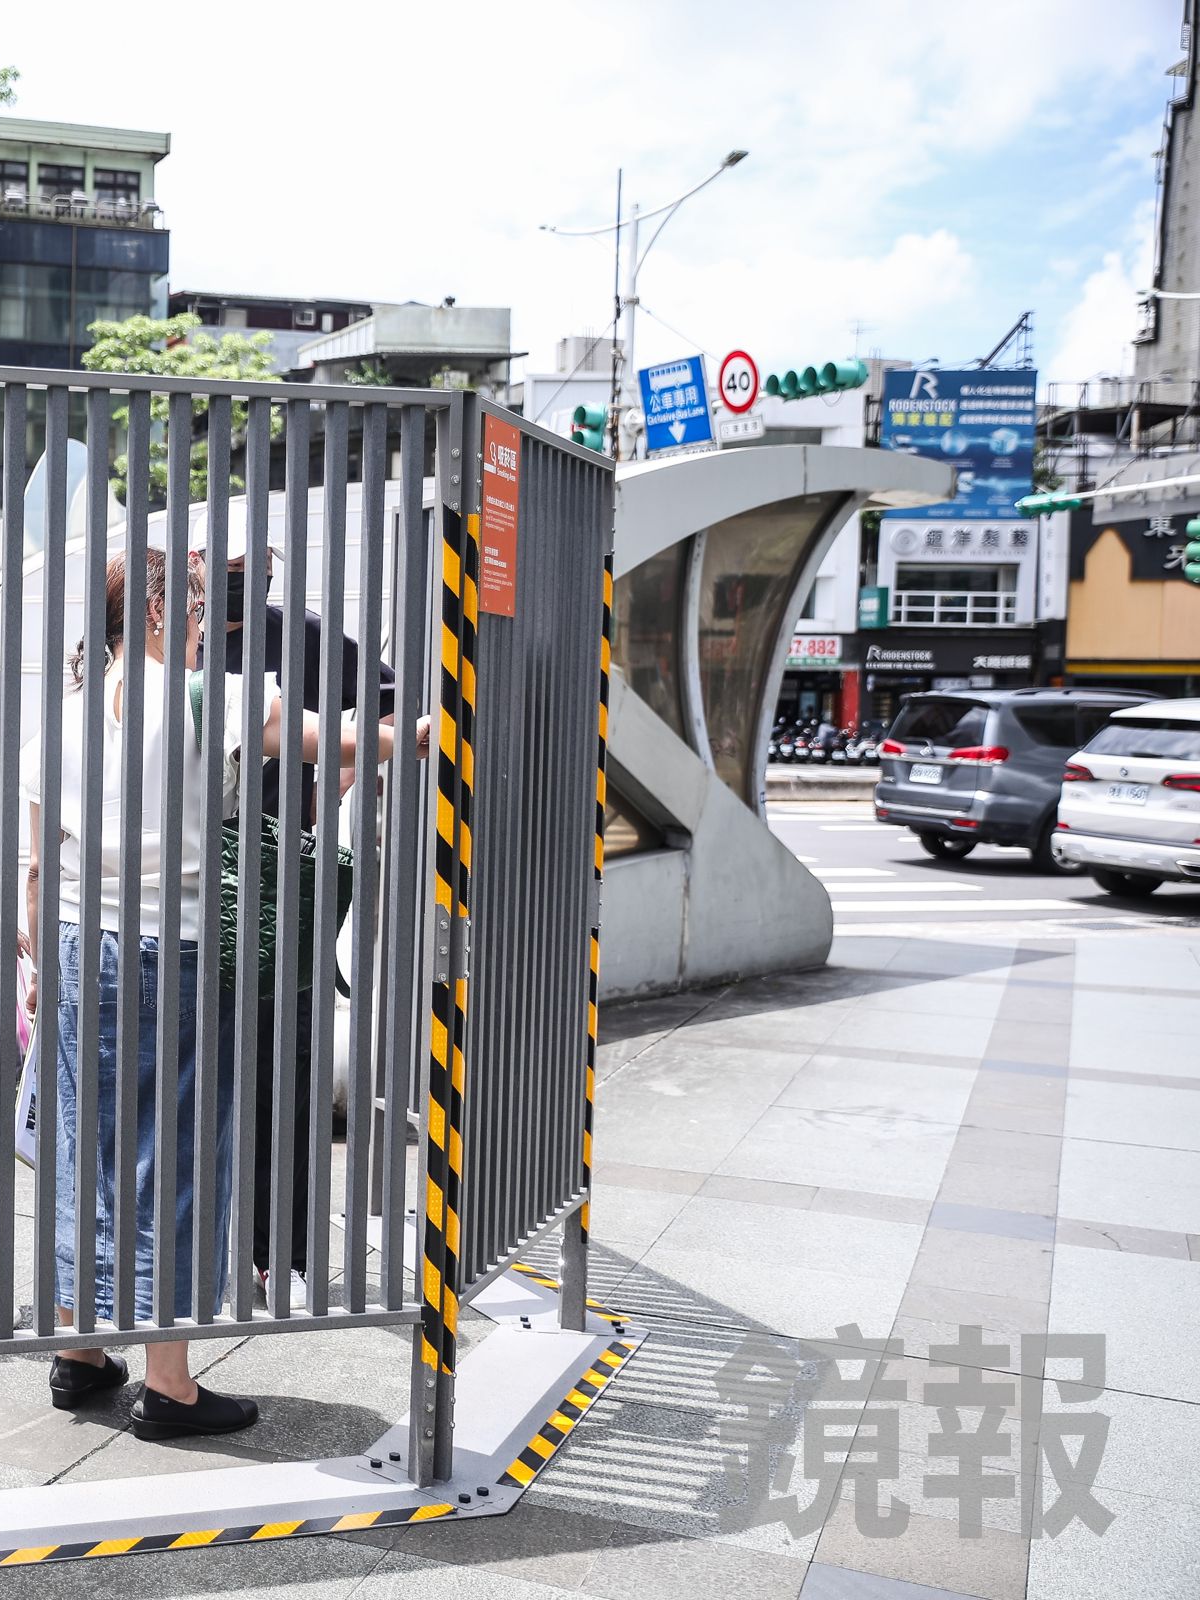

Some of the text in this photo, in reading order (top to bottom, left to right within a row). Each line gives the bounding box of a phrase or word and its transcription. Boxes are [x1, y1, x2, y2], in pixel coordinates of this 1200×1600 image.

[726, 371, 750, 394] 40
[650, 385, 698, 413] 公車專用
[888, 399, 957, 413] RODENSTOCK
[647, 410, 676, 426] Exclusive
[688, 406, 705, 418] Lane
[497, 444, 517, 471] 吸菸區
[496, 467, 509, 481] Smoking
[881, 650, 933, 661] RODENSTOCK
